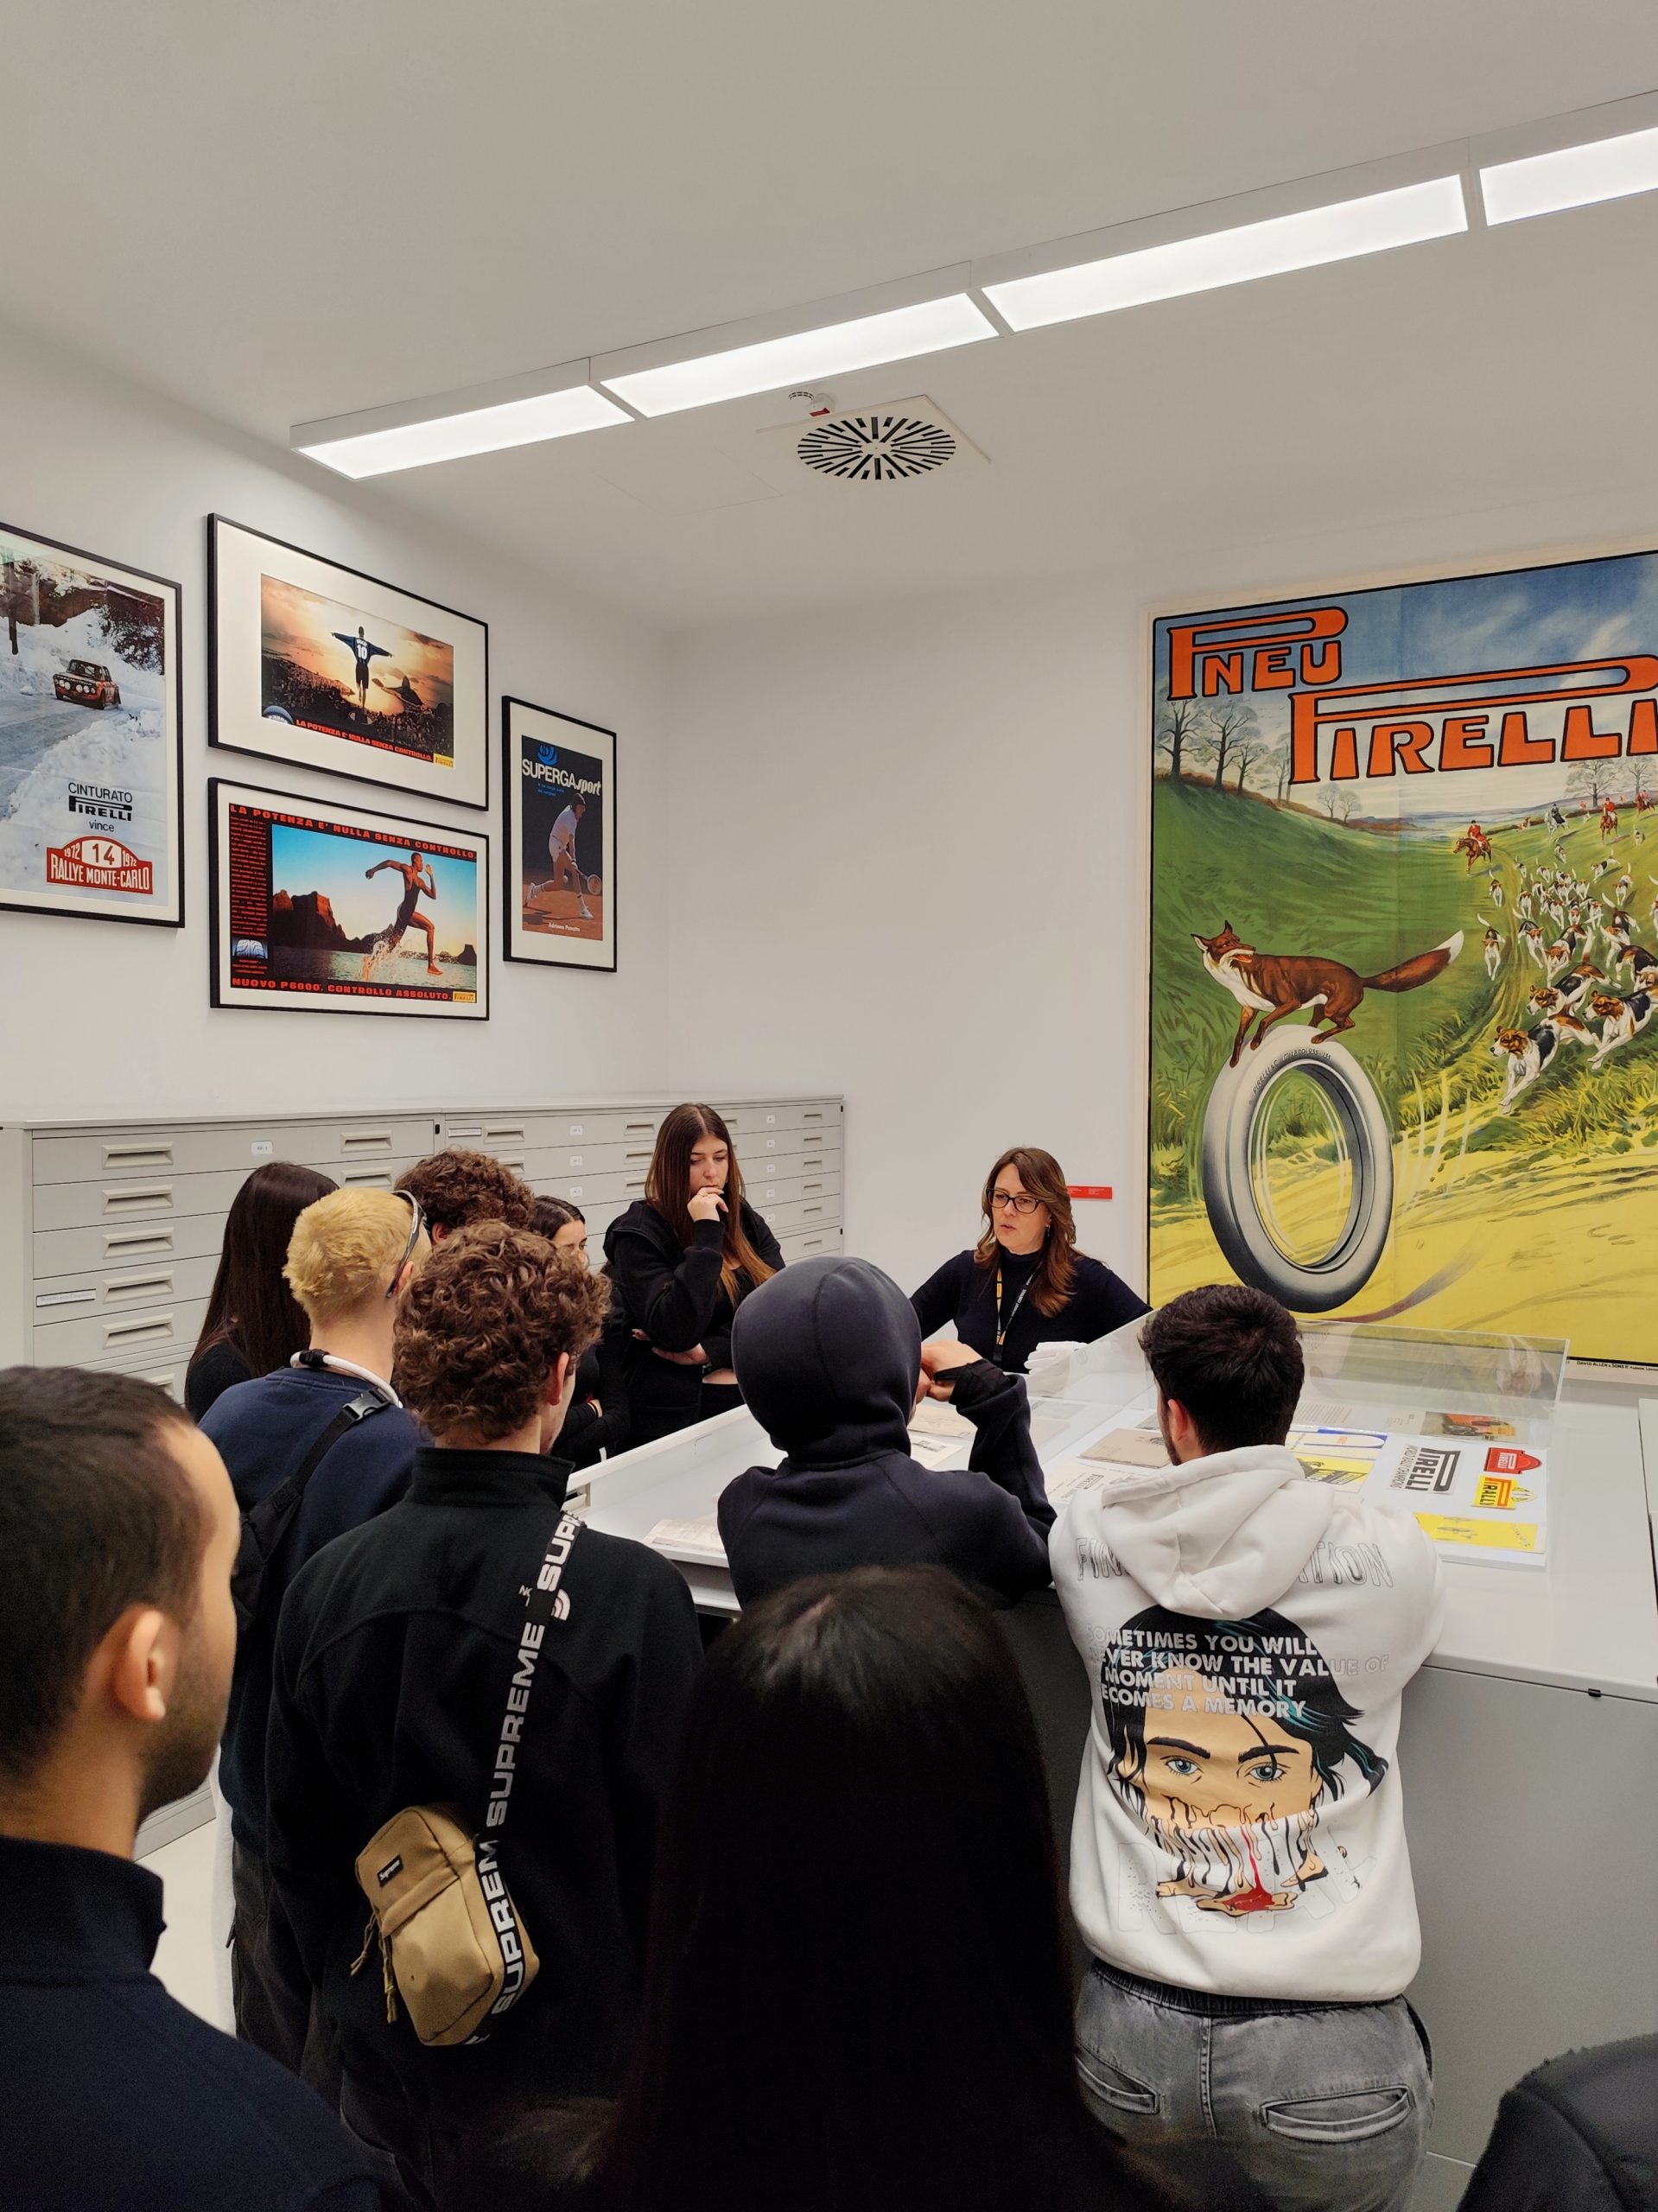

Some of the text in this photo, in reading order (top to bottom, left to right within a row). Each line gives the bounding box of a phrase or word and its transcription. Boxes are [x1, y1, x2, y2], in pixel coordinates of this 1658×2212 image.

[1166, 606, 1349, 701] PNEU
[296, 719, 306, 728] LA
[308, 722, 340, 737] POTENZA
[349, 734, 371, 745] NULLA
[372, 740, 393, 751] SENZA
[1288, 654, 1658, 785] PIRELLI
[68, 782, 132, 804] CINTURATO
[69, 795, 132, 821] PIRELLI
[89, 819, 115, 832] vince
[230, 804, 247, 815] LA
[253, 809, 314, 828] POTENZA
[333, 824, 370, 839] NULLA
[375, 833, 410, 847] SENZA
[64, 842, 137, 868] 1972 14 1972
[51, 852, 149, 891] RALLYE MONTE-CARLO
[232, 977, 276, 988] NUOVO
[327, 985, 392, 997] CONTROLLO
[1405, 1447, 1461, 1491] PIRELLI
[1085, 1624, 1318, 1656] SOMETIMES YOU WILL
[1151, 1651, 1223, 1672] KNOW
[1231, 1656, 1273, 1675] THE
[1280, 1658, 1358, 1676] VALUE
[1365, 1654, 1389, 1674] OF
[1104, 1666, 1297, 1697] MOMENT UNTIL IT
[1101, 1683, 1306, 1719] ECOMES A MEMORY
[486, 1622, 545, 1827] SUPREME
